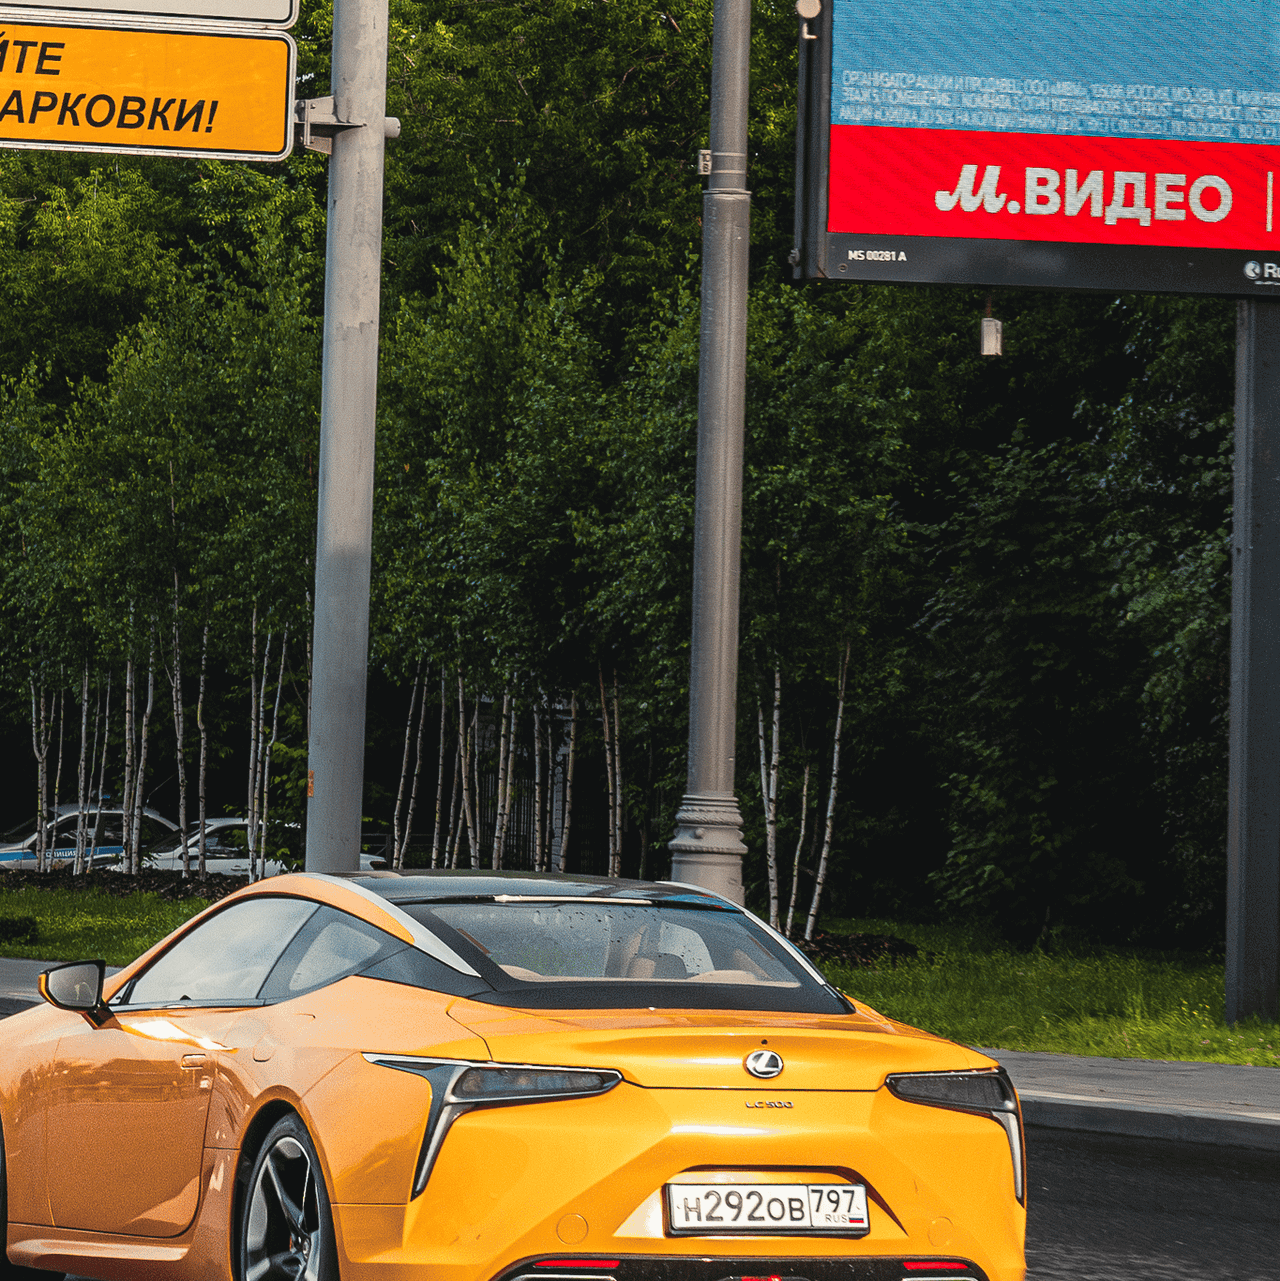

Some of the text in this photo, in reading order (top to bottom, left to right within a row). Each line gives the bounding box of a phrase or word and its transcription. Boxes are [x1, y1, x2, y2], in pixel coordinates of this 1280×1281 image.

[935, 164, 1233, 227] М.ВИДЕО
[897, 251, 907, 261] A
[745, 1100, 795, 1109] LC 500
[810, 1188, 856, 1214] 797
[824, 1213, 848, 1223] RUS
